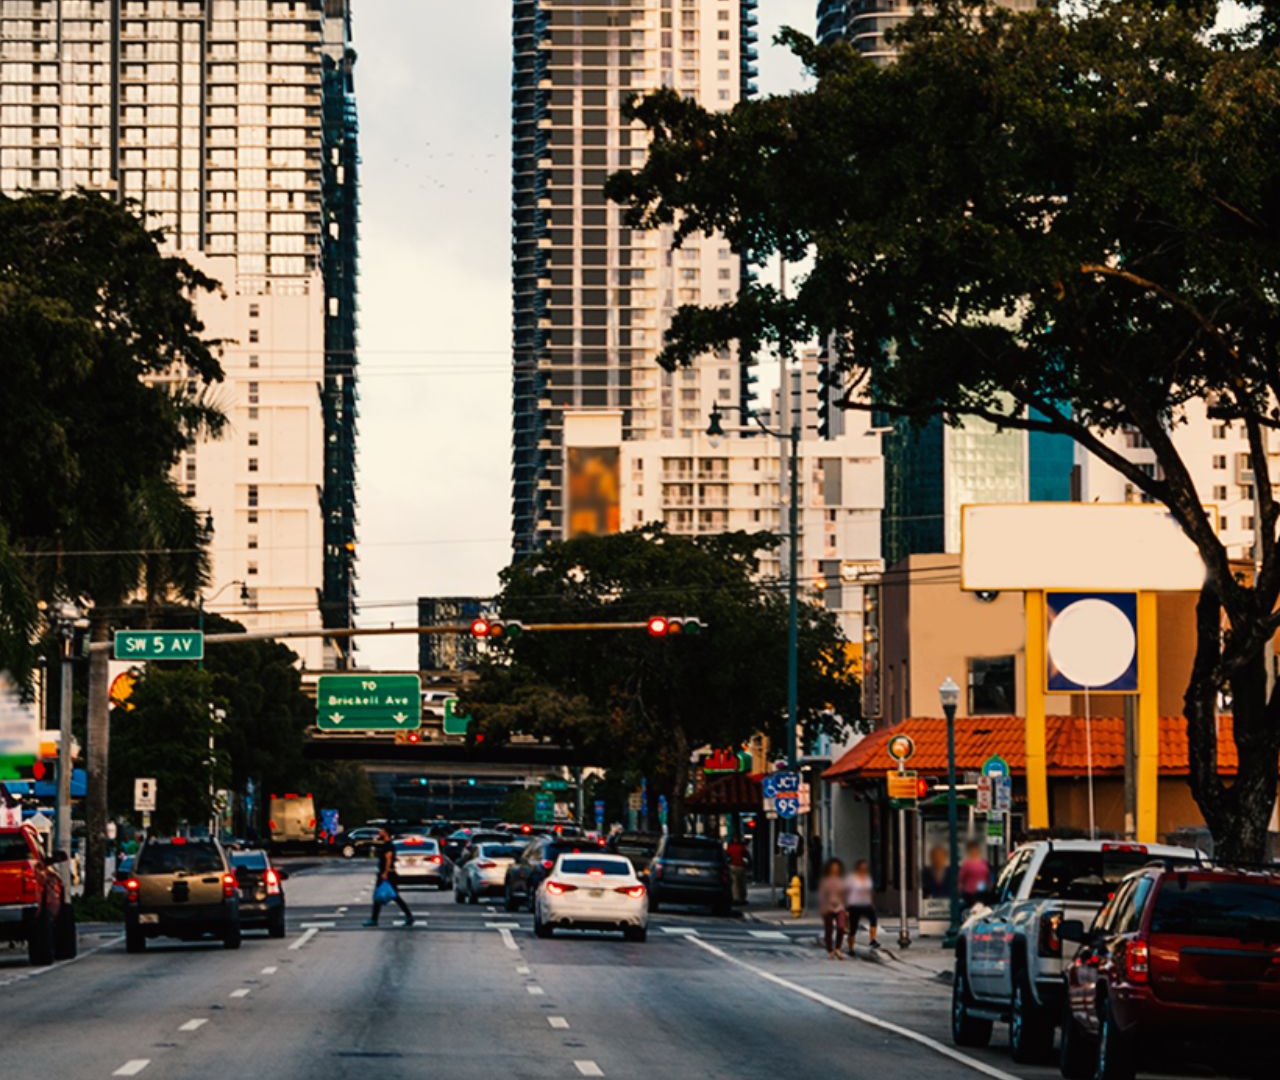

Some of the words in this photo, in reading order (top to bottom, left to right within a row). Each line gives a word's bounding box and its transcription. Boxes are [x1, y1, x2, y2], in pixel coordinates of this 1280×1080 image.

[126, 637, 147, 652] SW
[153, 636, 165, 654] 5
[171, 637, 193, 652] AV
[361, 680, 377, 691] TO
[328, 695, 379, 706] Brickell
[385, 695, 409, 706] Ave
[777, 777, 797, 789] JCT
[778, 800, 797, 816] 95
